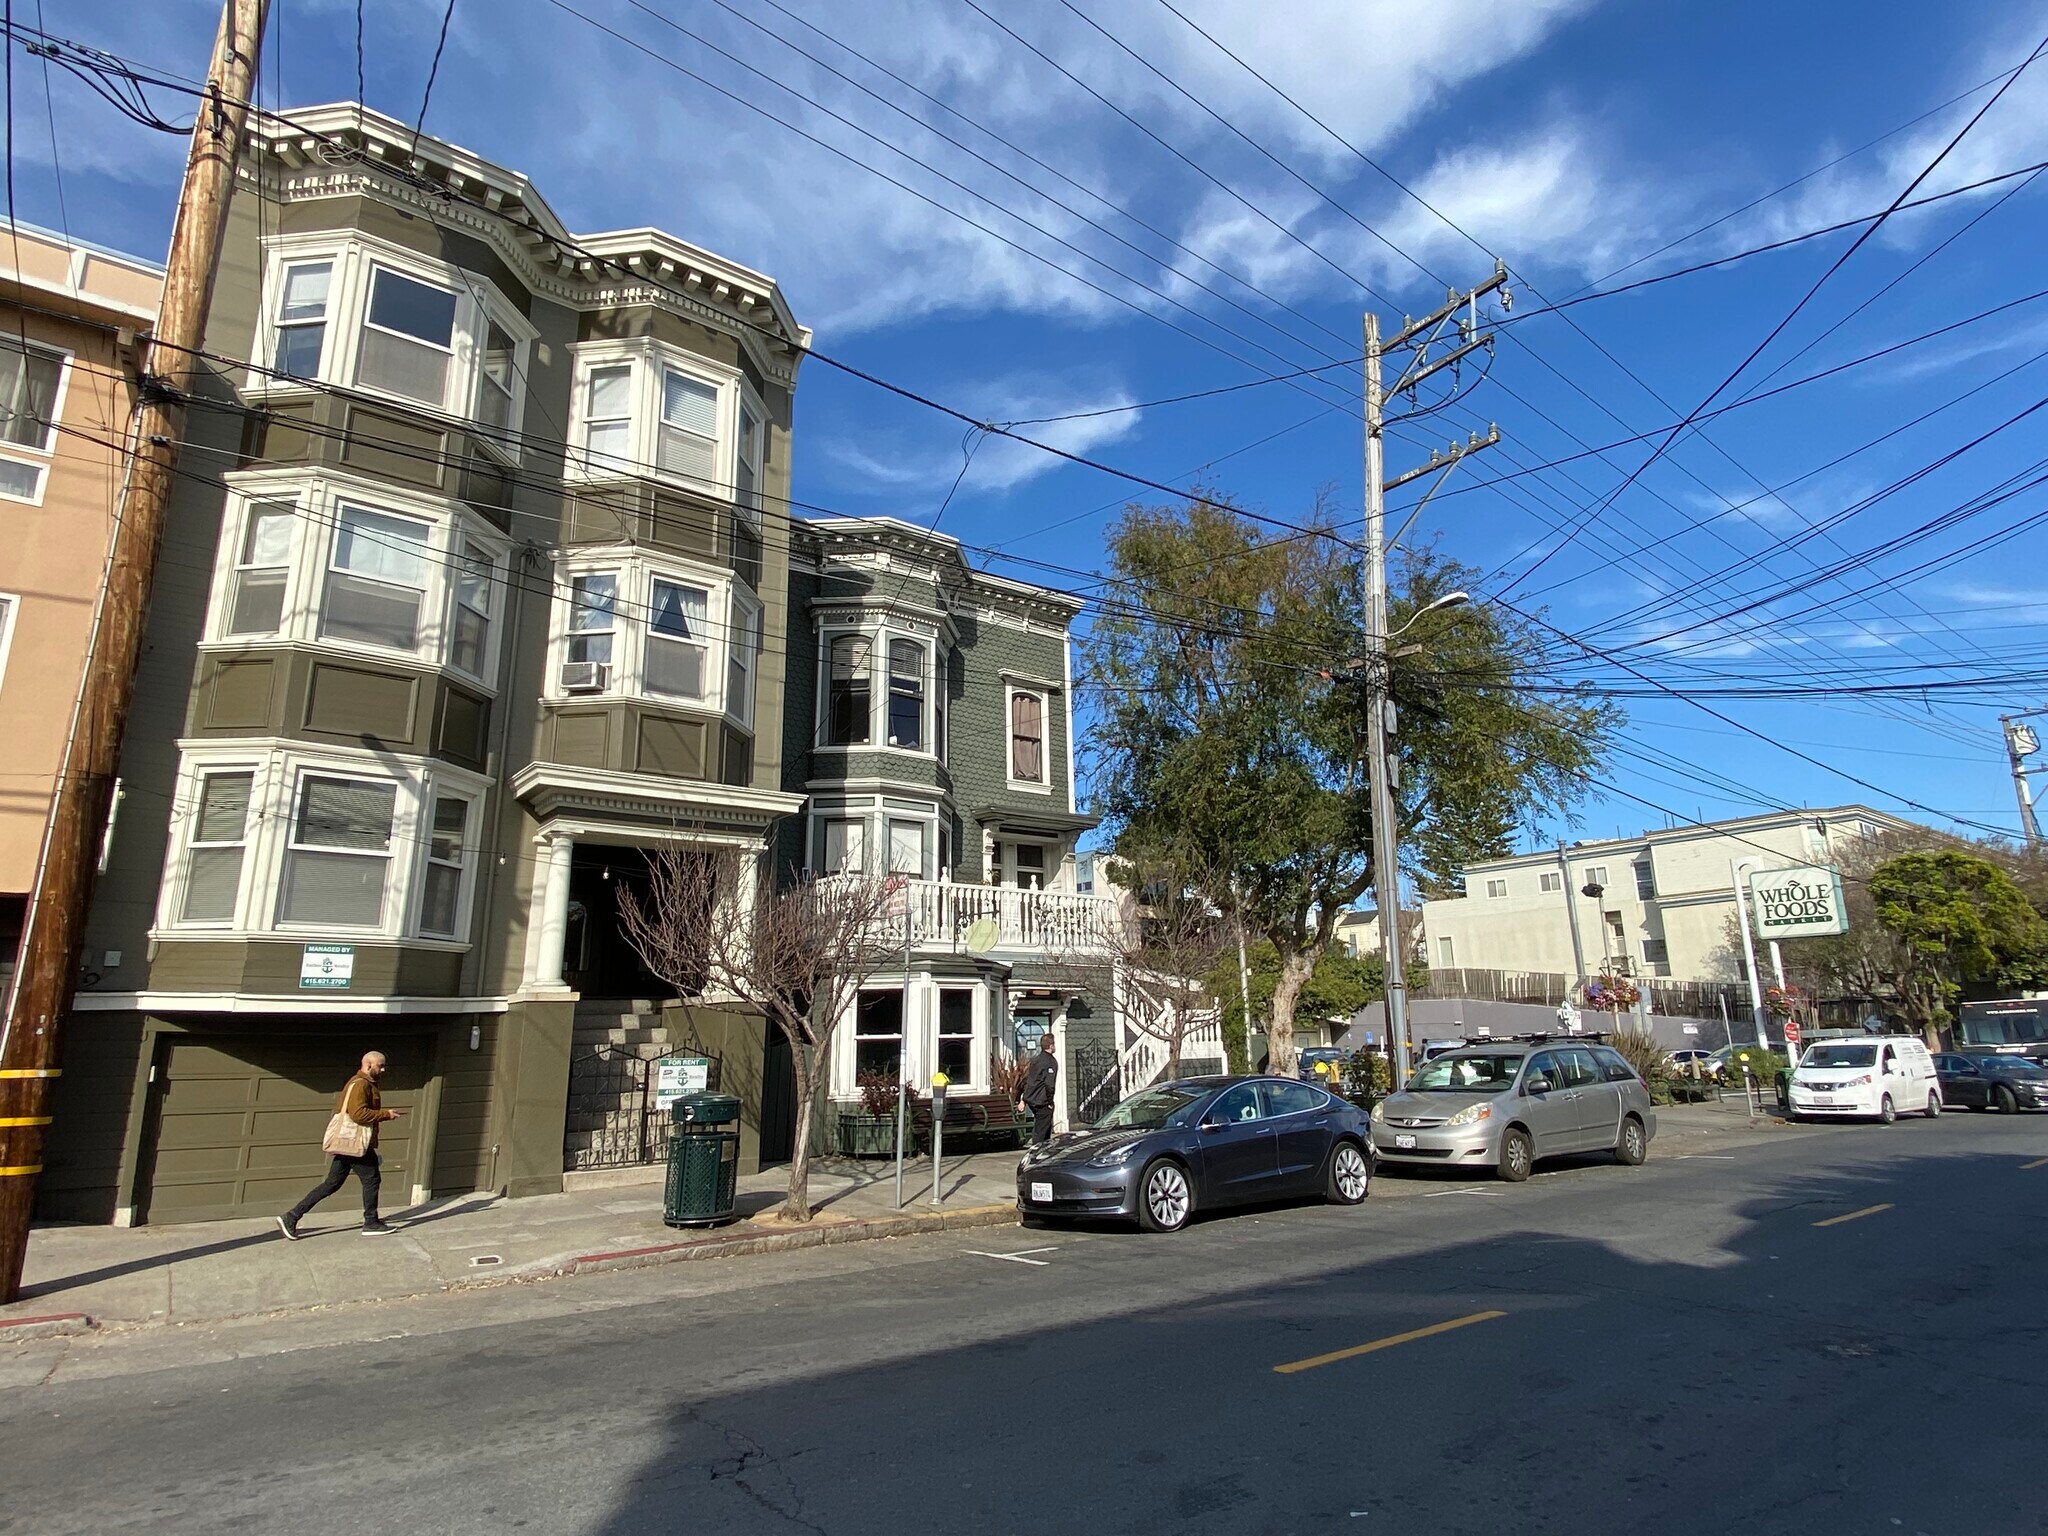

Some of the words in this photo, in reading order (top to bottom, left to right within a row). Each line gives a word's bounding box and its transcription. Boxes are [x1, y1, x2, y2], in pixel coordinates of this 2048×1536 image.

[1757, 882, 1830, 904] WHOLE
[1764, 899, 1829, 919] FOODS
[1767, 917, 1829, 926] MARKET
